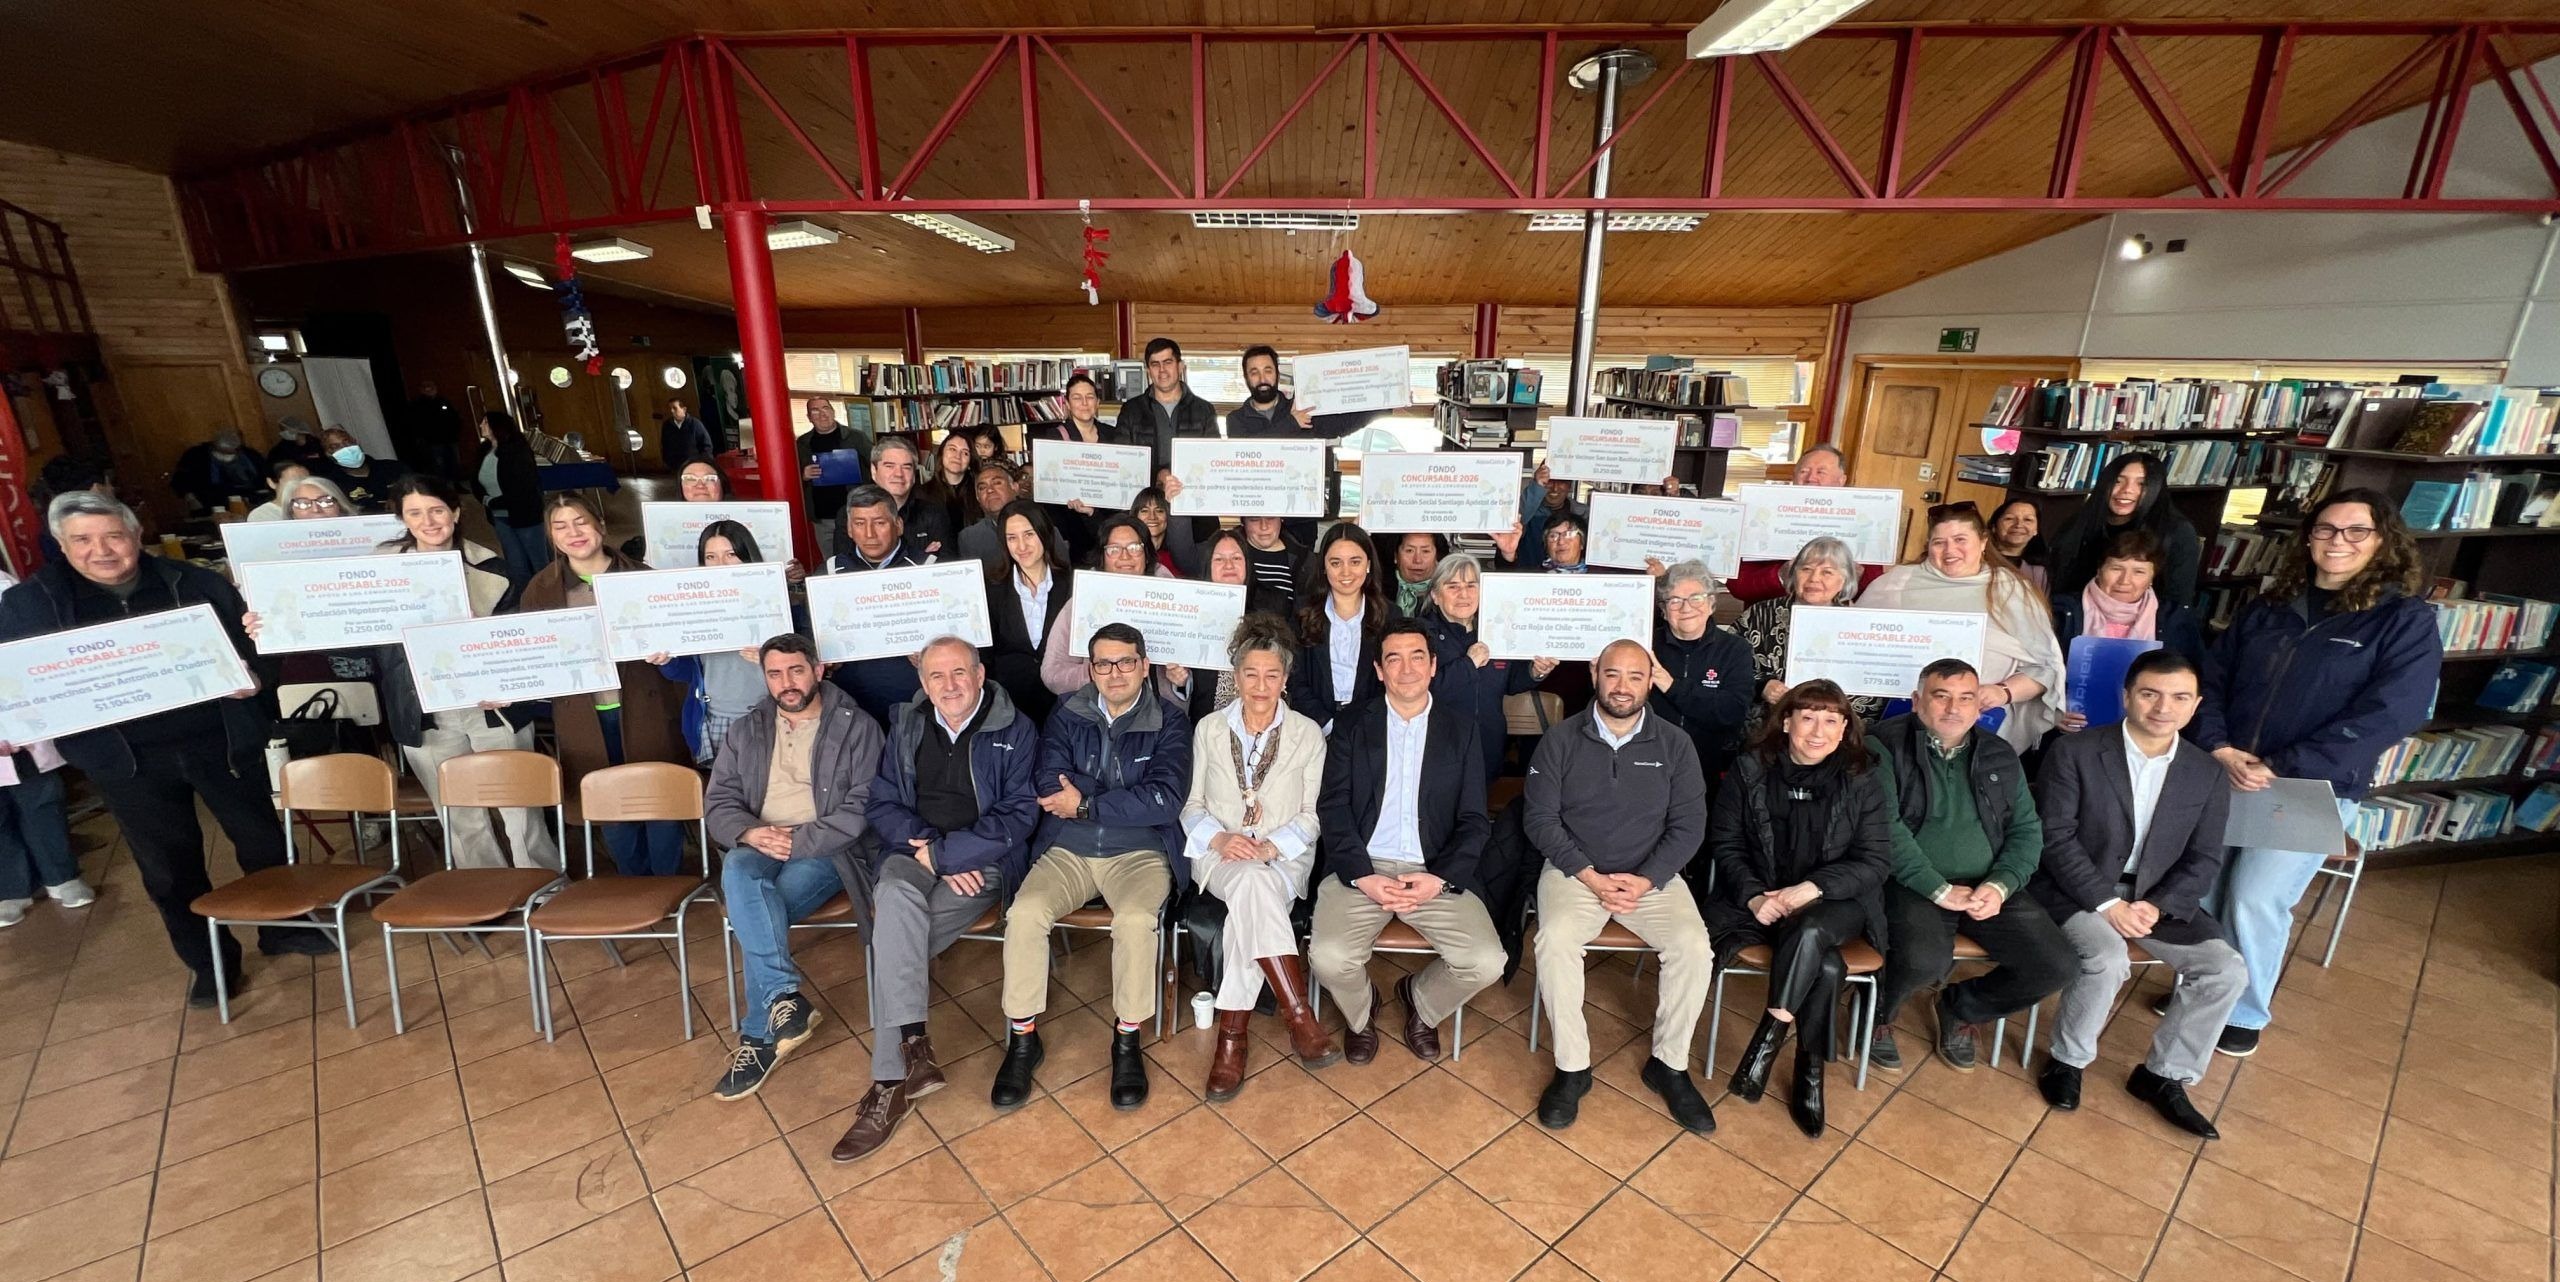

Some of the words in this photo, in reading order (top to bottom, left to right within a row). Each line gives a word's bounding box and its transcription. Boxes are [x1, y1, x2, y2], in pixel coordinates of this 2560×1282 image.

[1653, 509, 1680, 517] FONDO
[1778, 505, 1834, 514] CONCURSABLE
[1628, 516, 1682, 526] CONCURSABLE
[1683, 519, 1702, 527] 2026
[309, 530, 341, 538] FONDO
[279, 538, 347, 549] CONCURSABLE
[350, 537, 372, 545] 2026
[339, 570, 376, 579] FONDO
[304, 580, 382, 593] CONCURSABLE
[384, 578, 410, 587] 2026
[677, 581, 710, 590] FONDO
[882, 582, 912, 591] FONDO
[648, 591, 715, 603] CONCURSABLE
[717, 589, 739, 598] 2026
[855, 591, 917, 605] CONCURSABLE
[919, 589, 939, 599] 2026
[1145, 591, 1174, 600] FONDO
[1552, 588, 1581, 596] FONDO
[1116, 598, 1177, 611] CONCURSABLE
[1178, 603, 1199, 613] 2026
[1524, 598, 1584, 606] CONCURSABLE
[301, 608, 346, 618] Fundación
[348, 605, 398, 616] Hipoterapia
[400, 603, 426, 612] Chiloé
[836, 622, 861, 631] Comité
[892, 617, 918, 626] potable
[919, 615, 935, 623] rural
[947, 612, 968, 620] Cucao
[1143, 627, 1169, 637] potable
[1170, 629, 1186, 638] rural
[1188, 631, 1196, 639] de
[1870, 623, 1903, 632] FONDO
[490, 628, 525, 639] FONDO
[681, 634, 723, 643] $1.250.000
[1838, 632, 1905, 642] CONCURSABLE
[1907, 635, 1931, 644] 2026
[460, 637, 531, 652] CONCURSABLE
[534, 635, 556, 645] 2026
[885, 634, 924, 645] $1.250.000
[68, 640, 116, 656] FONDO
[1146, 646, 1175, 655] 250.000
[28, 648, 127, 677] CONCURSABLE
[129, 641, 160, 656] 2026
[33, 694, 47, 706] de
[50, 684, 93, 702] vecinos
[94, 679, 115, 693] San
[117, 670, 158, 688] Antonio
[160, 666, 173, 678] de
[175, 657, 217, 675] Chadmo
[499, 680, 544, 691] $1.250.000
